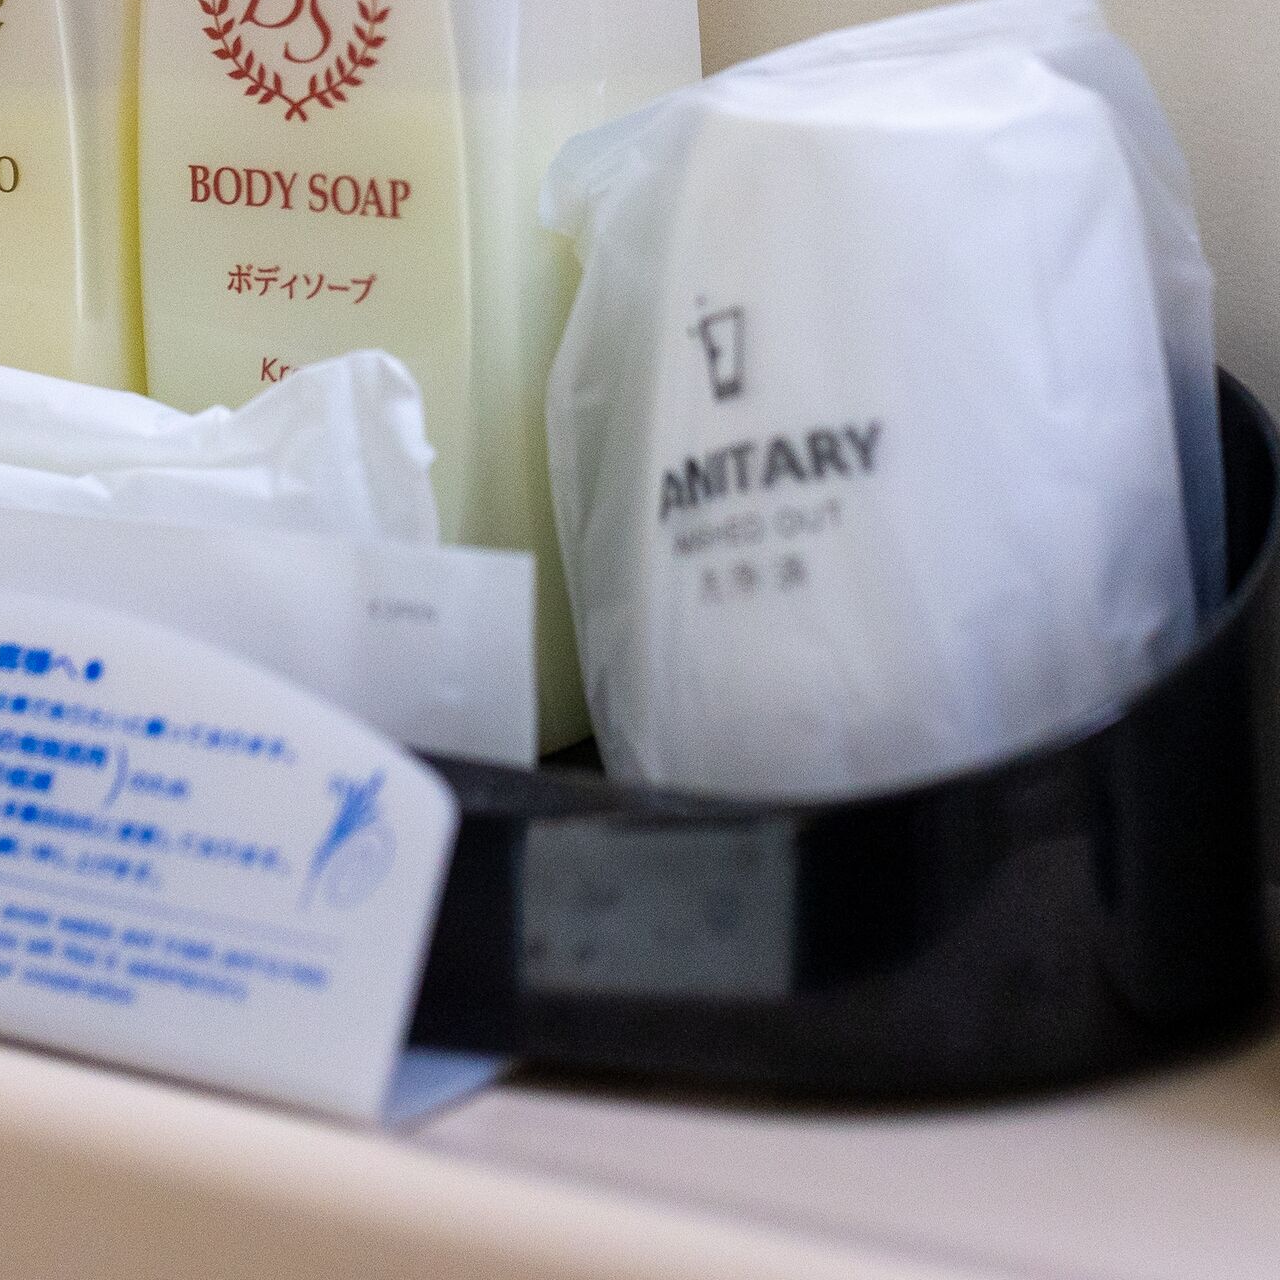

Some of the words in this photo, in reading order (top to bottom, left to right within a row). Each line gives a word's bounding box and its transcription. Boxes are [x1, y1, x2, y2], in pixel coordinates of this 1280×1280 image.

[187, 163, 301, 212] BODY
[307, 173, 413, 221] SOAP
[226, 263, 377, 306] ボディソープ
[657, 419, 882, 523] ANITARY
